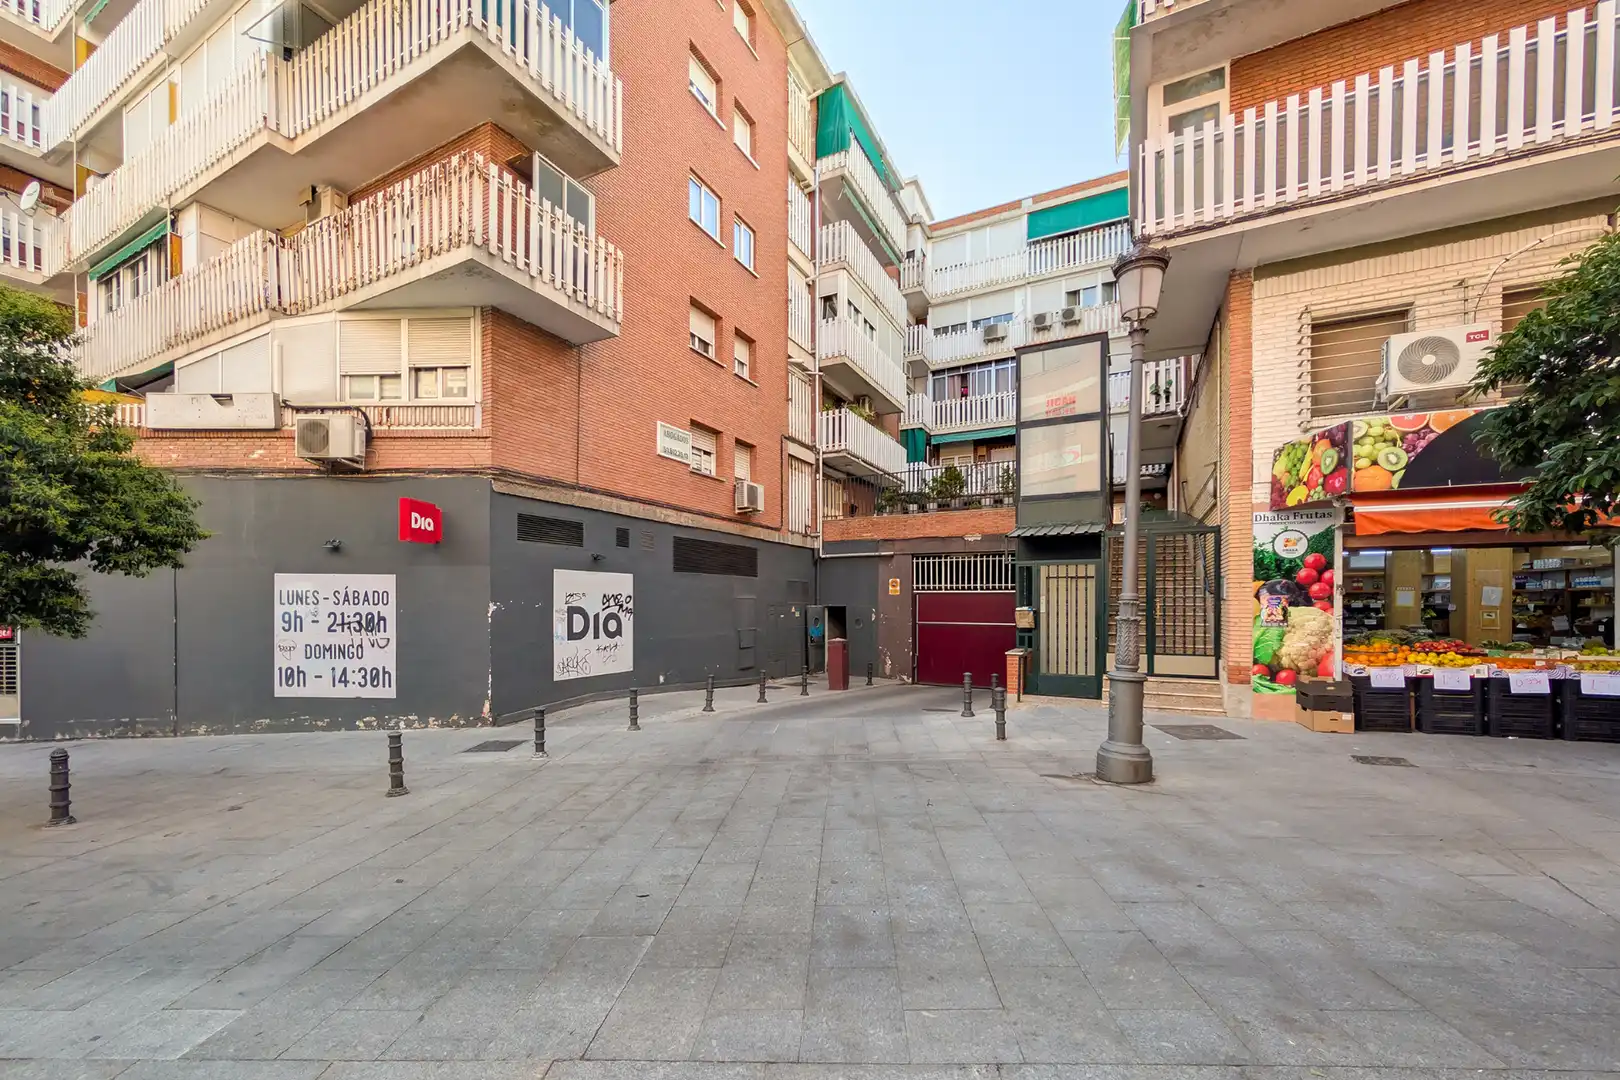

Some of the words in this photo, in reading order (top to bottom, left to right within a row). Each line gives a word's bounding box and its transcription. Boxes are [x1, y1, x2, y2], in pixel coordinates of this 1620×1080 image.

[1254, 513, 1290, 522] Dhaka
[1293, 511, 1333, 520] Frutas
[279, 590, 320, 606] LUNES
[332, 586, 390, 606] SÁBADO
[281, 610, 303, 632] 9h
[327, 611, 388, 633] 21:30h
[304, 644, 364, 660] DOMINGO
[277, 665, 306, 688] 10h
[331, 666, 392, 688] 14:30h
